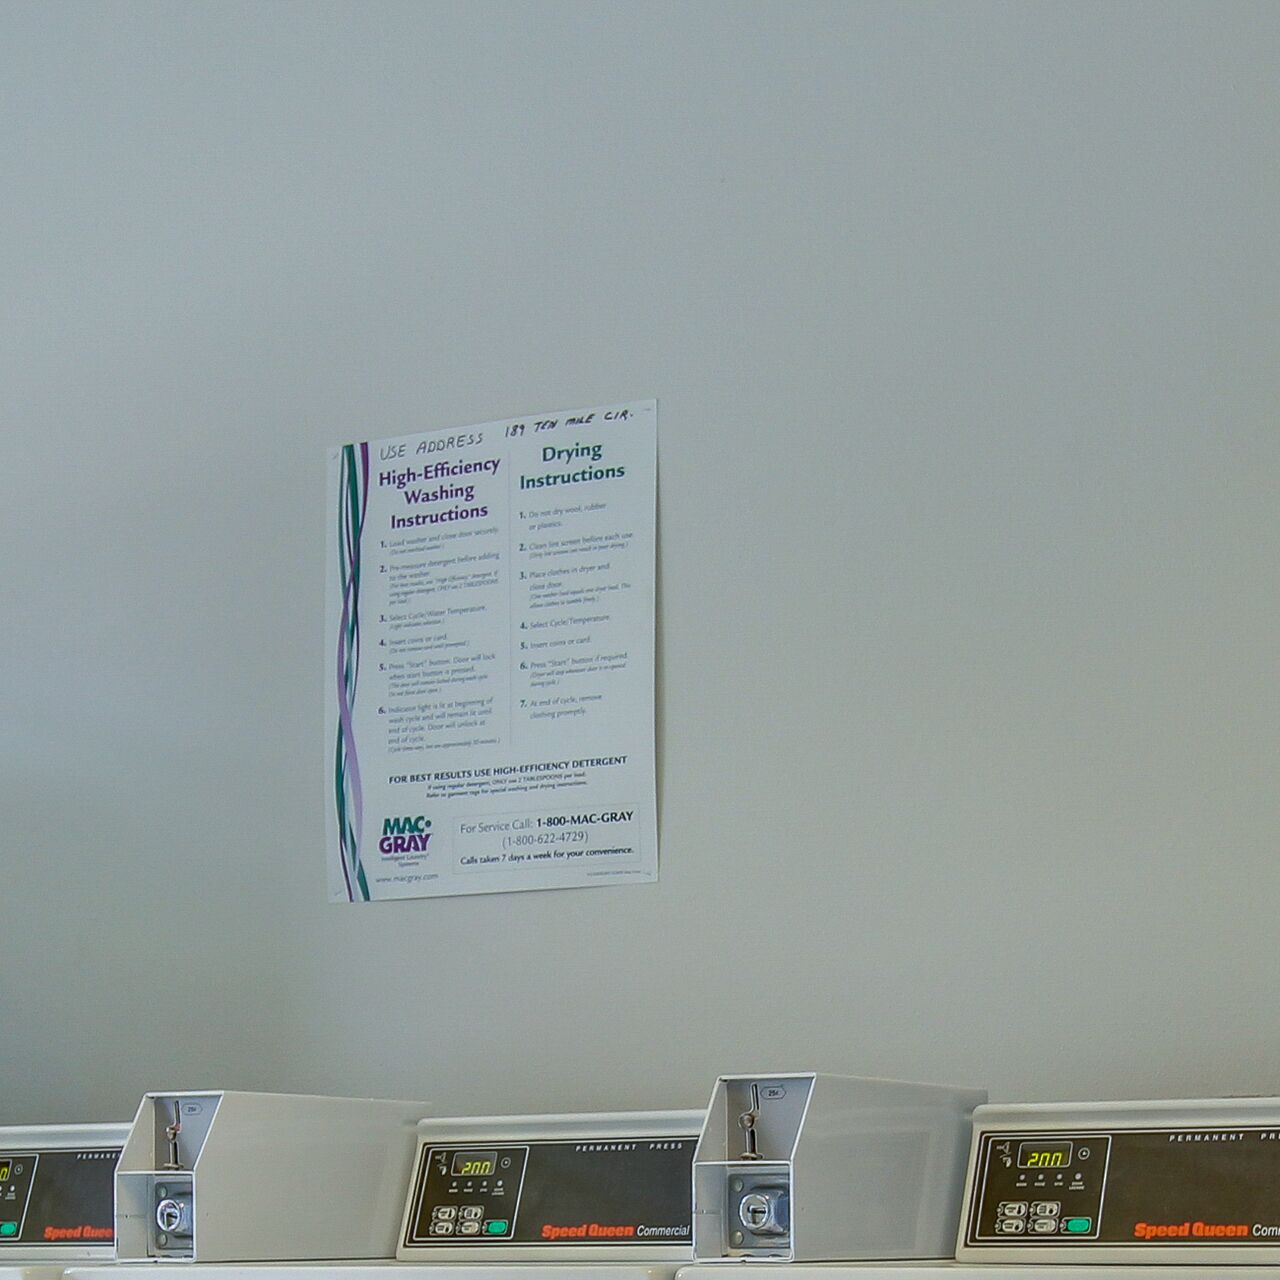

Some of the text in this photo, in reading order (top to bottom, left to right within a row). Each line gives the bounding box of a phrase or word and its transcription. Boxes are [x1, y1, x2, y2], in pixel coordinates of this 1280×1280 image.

[380, 444, 406, 461] USE
[416, 432, 484, 454] ADDRESS
[505, 424, 525, 437] 189
[534, 418, 558, 433] TEN
[565, 413, 595, 427] MILE
[542, 442, 602, 464] Drying
[379, 457, 501, 488] High-Efficiency
[520, 464, 625, 489] Instructions
[405, 483, 474, 505] Washing
[391, 504, 488, 529] Instructions
[530, 621, 548, 629] Select
[388, 756, 627, 784] FOR BEST RESULTS USE HIGH-EFFICIENCY DETERGENT
[460, 811, 634, 833] For Service Call: 1-800-MAC-GRAY
[379, 833, 432, 854] GRAY
[502, 831, 589, 849] (1-800-622-4729)
[460, 855, 477, 865] Calls
[480, 854, 500, 863] taken
[502, 854, 506, 862] 7
[508, 853, 524, 863] days
[533, 851, 551, 860] week
[553, 850, 564, 859] for
[566, 851, 584, 860] your
[586, 846, 634, 856] convenience.
[575, 1142, 684, 1152] PERMANENT PRESS
[1169, 1133, 1245, 1142] PERMANENT
[44, 1226, 113, 1241] Speed Quee
[541, 1224, 689, 1239] Speed Queen Commercial
[1134, 1222, 1190, 1239] Speed
[1192, 1222, 1249, 1237] Queen
